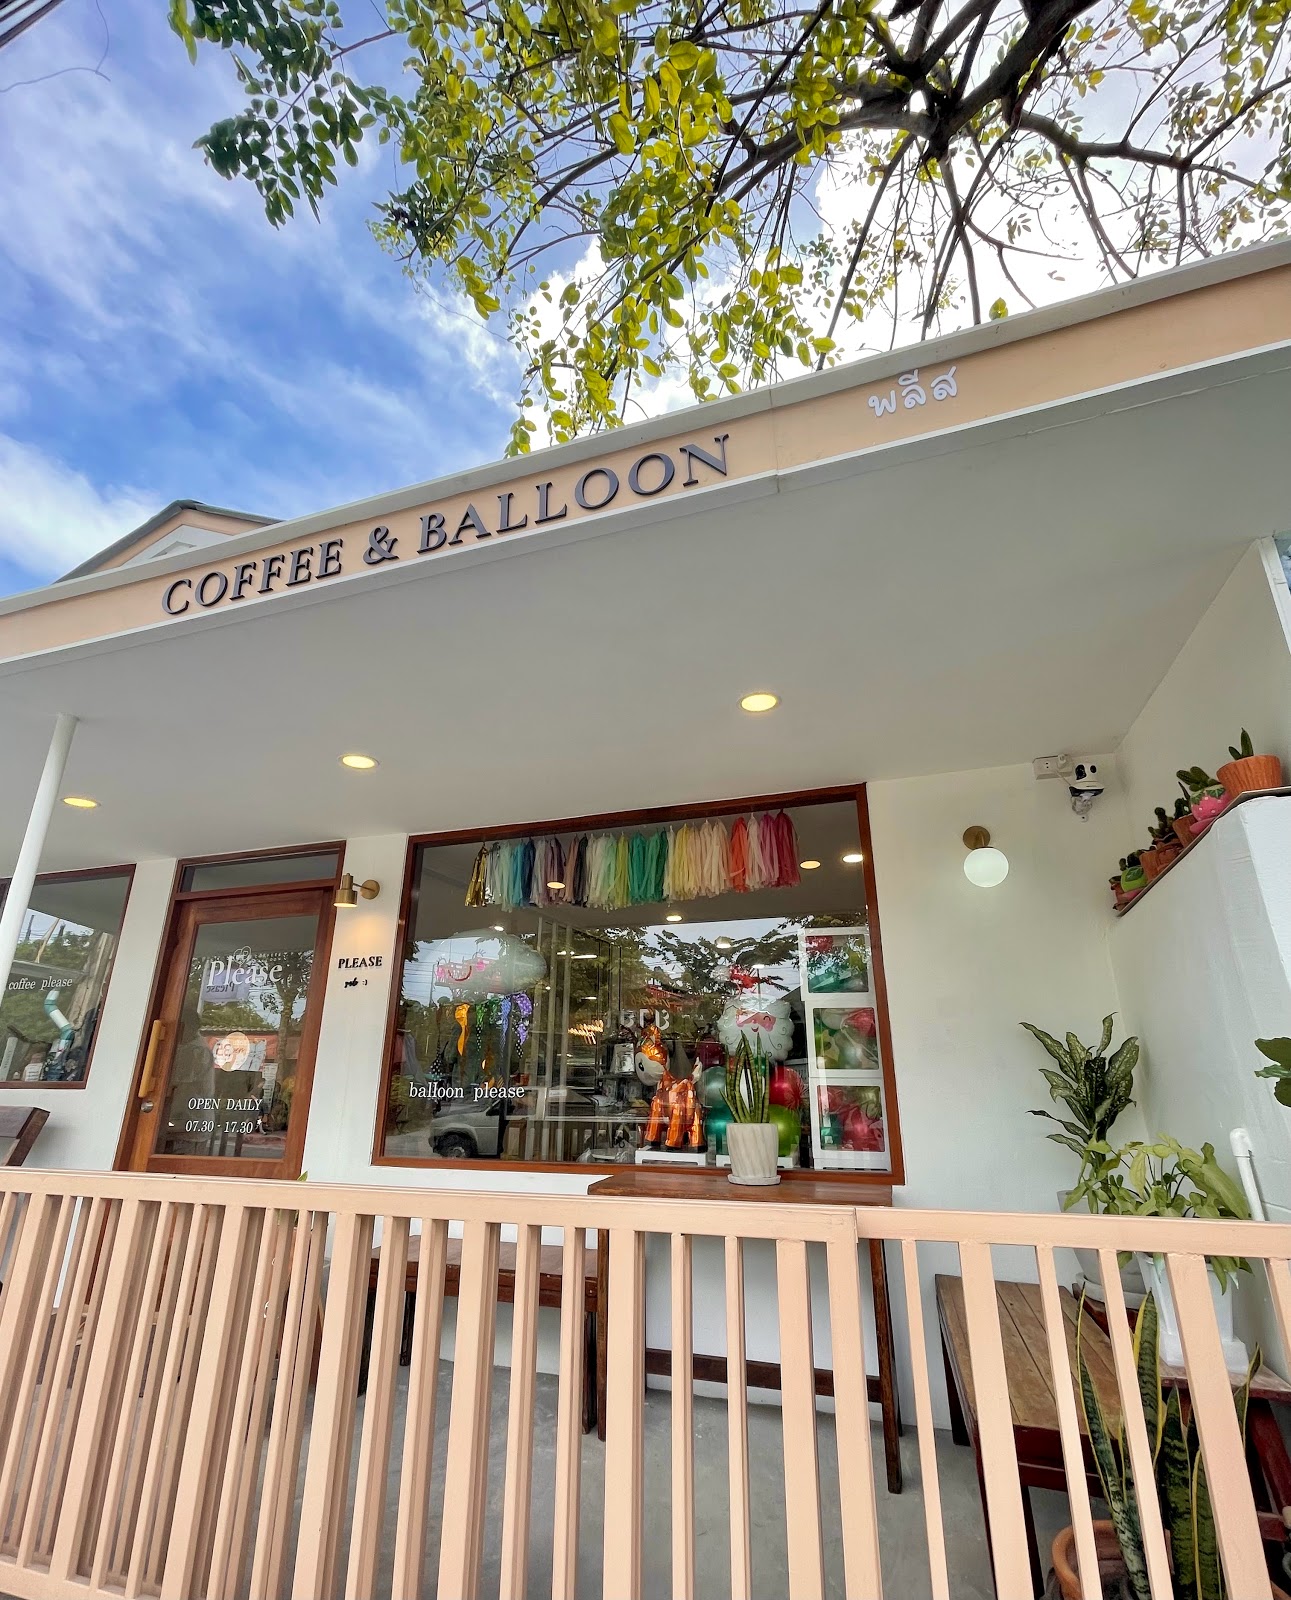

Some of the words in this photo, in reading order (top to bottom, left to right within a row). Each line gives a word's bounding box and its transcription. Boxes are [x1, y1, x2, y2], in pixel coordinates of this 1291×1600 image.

[867, 366, 958, 417] พลีส
[162, 538, 343, 615] COFFEE
[363, 526, 399, 565] &
[417, 433, 729, 554] BALLOON
[207, 955, 283, 986] Please
[338, 956, 383, 969] PLEASE
[8, 978, 36, 990] coffee
[40, 976, 73, 991] please
[409, 1081, 464, 1098] balloon
[473, 1082, 525, 1102] please
[188, 1097, 221, 1110] OPEN
[226, 1098, 263, 1111] DAILY
[185, 1120, 214, 1132] 07.30
[223, 1121, 254, 1134] 17.30
